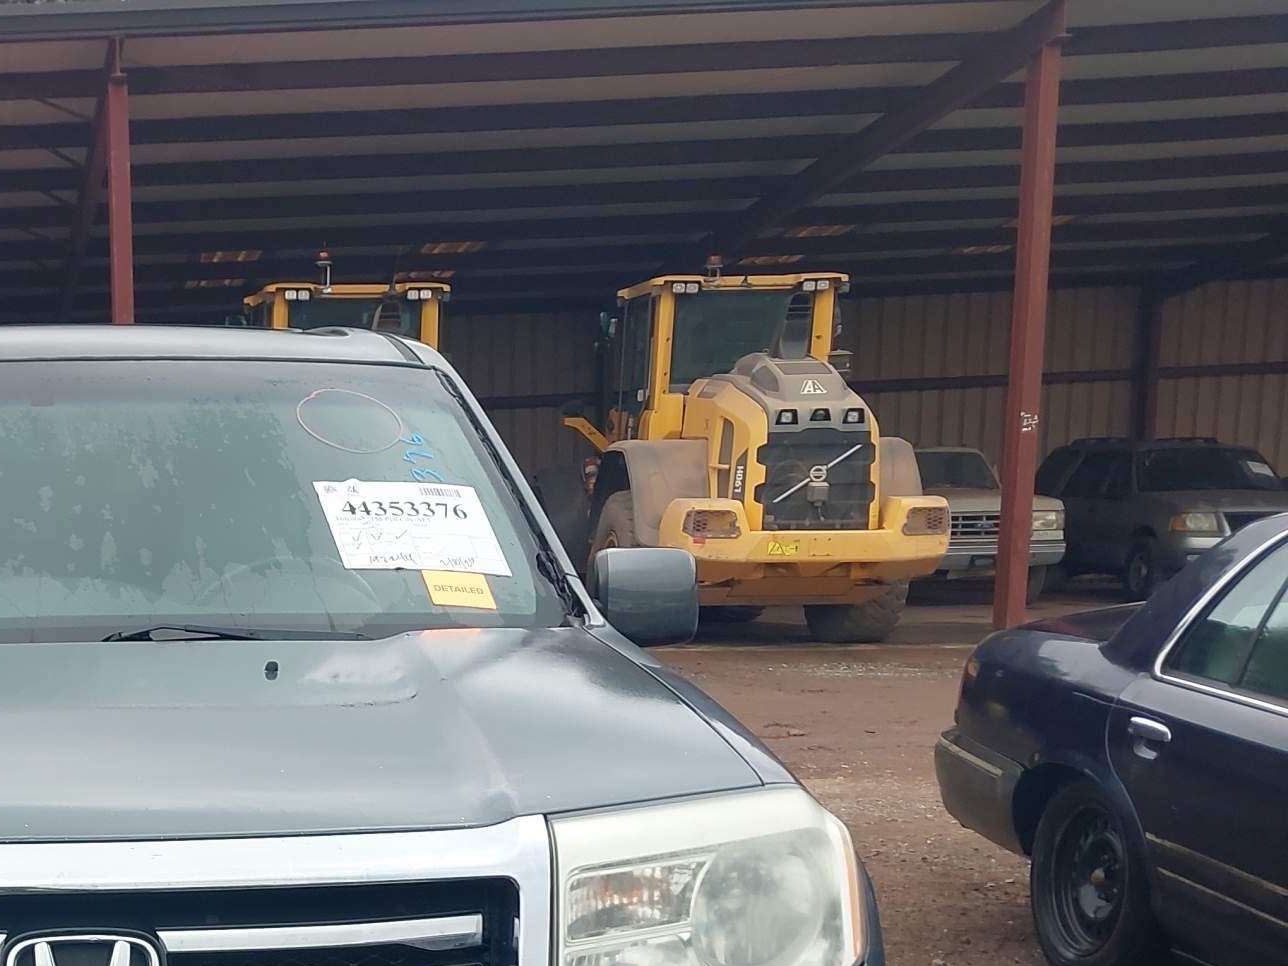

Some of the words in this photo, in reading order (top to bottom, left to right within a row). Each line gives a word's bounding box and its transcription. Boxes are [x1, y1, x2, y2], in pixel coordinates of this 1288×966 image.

[734, 465, 744, 493] L90H
[341, 500, 468, 520] 44353376
[433, 584, 484, 595] DETAILED
